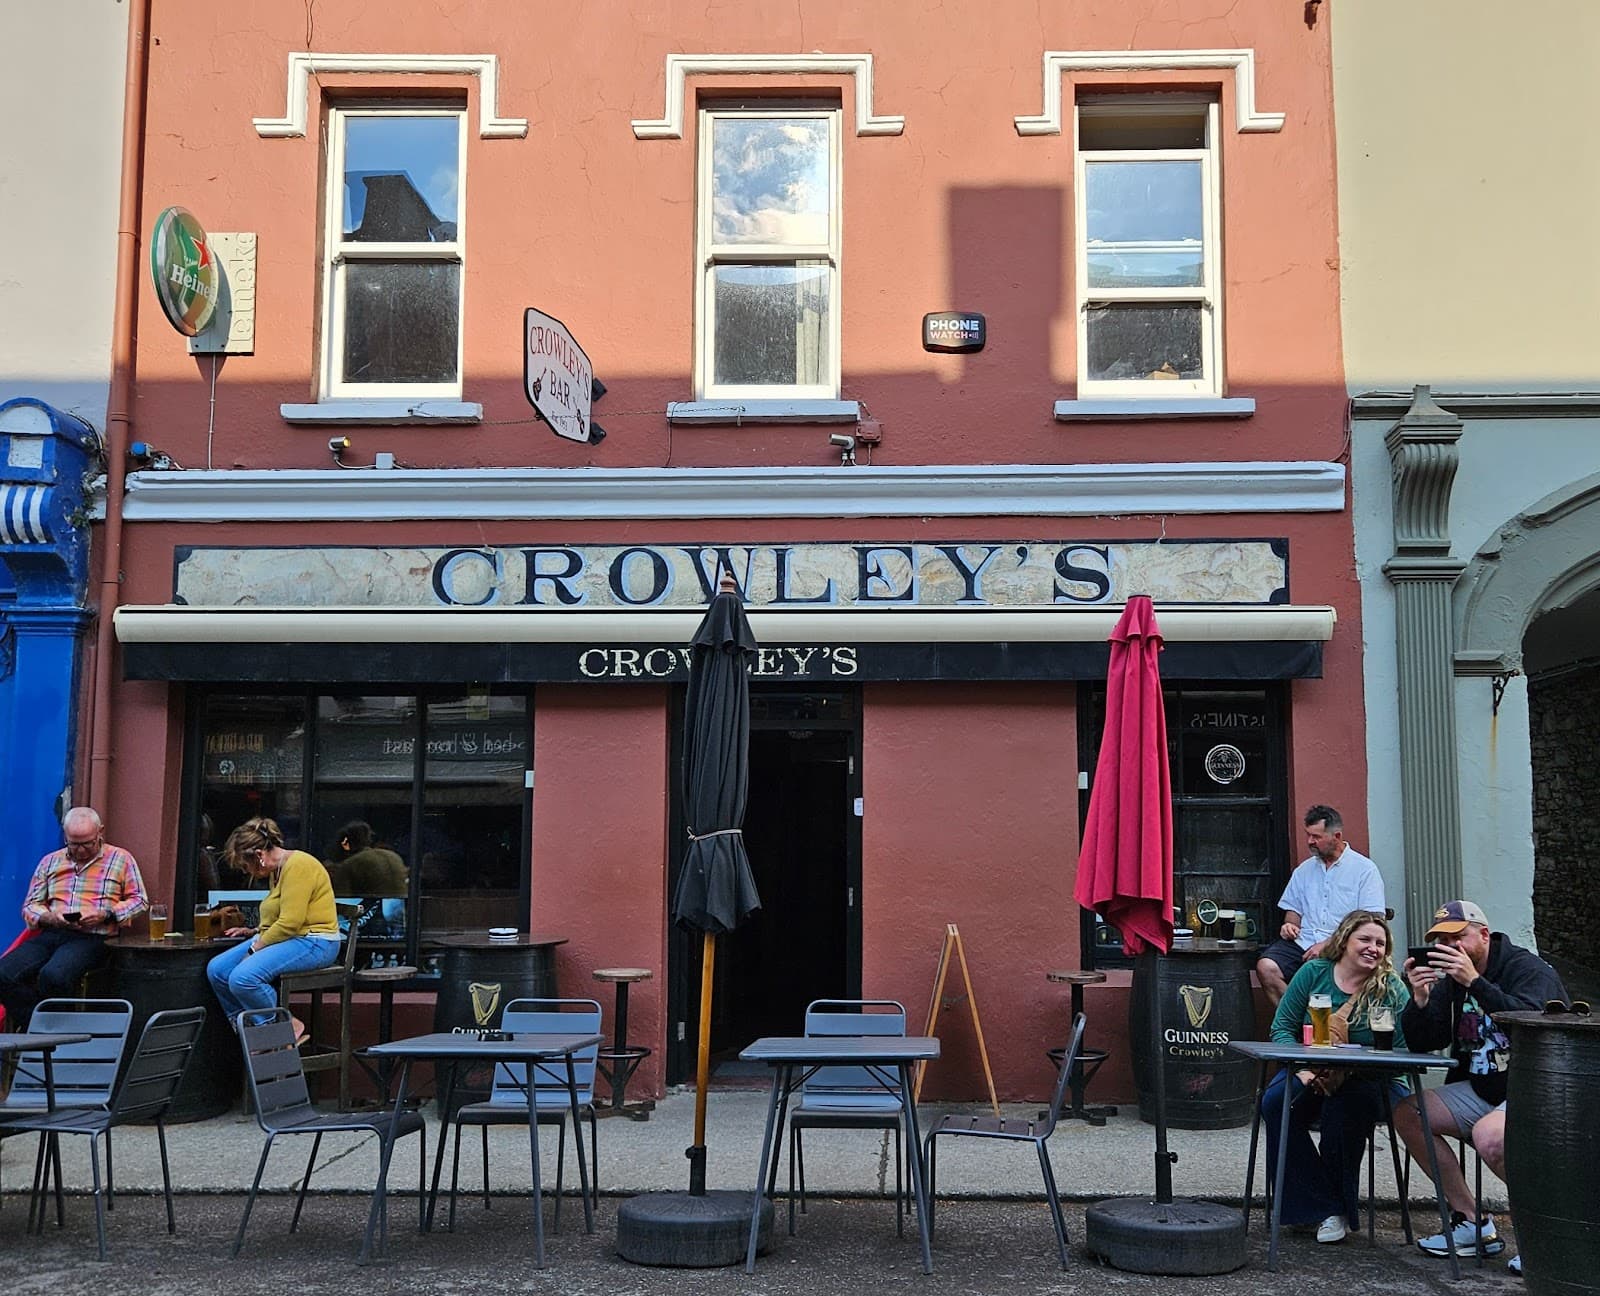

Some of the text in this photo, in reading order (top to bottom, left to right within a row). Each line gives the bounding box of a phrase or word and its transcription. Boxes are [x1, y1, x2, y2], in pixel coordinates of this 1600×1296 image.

[170, 264, 210, 297] Heine
[930, 319, 979, 331] PHONE
[930, 331, 968, 340] WATCH
[530, 326, 589, 401] CROWLEY'S
[550, 370, 571, 410] BAR
[432, 546, 1115, 605] CROWLEY'S
[579, 646, 858, 677] CROEY'S
[1164, 1029, 1229, 1044] GUINNESS
[1169, 1046, 1224, 1059] Crowley's
